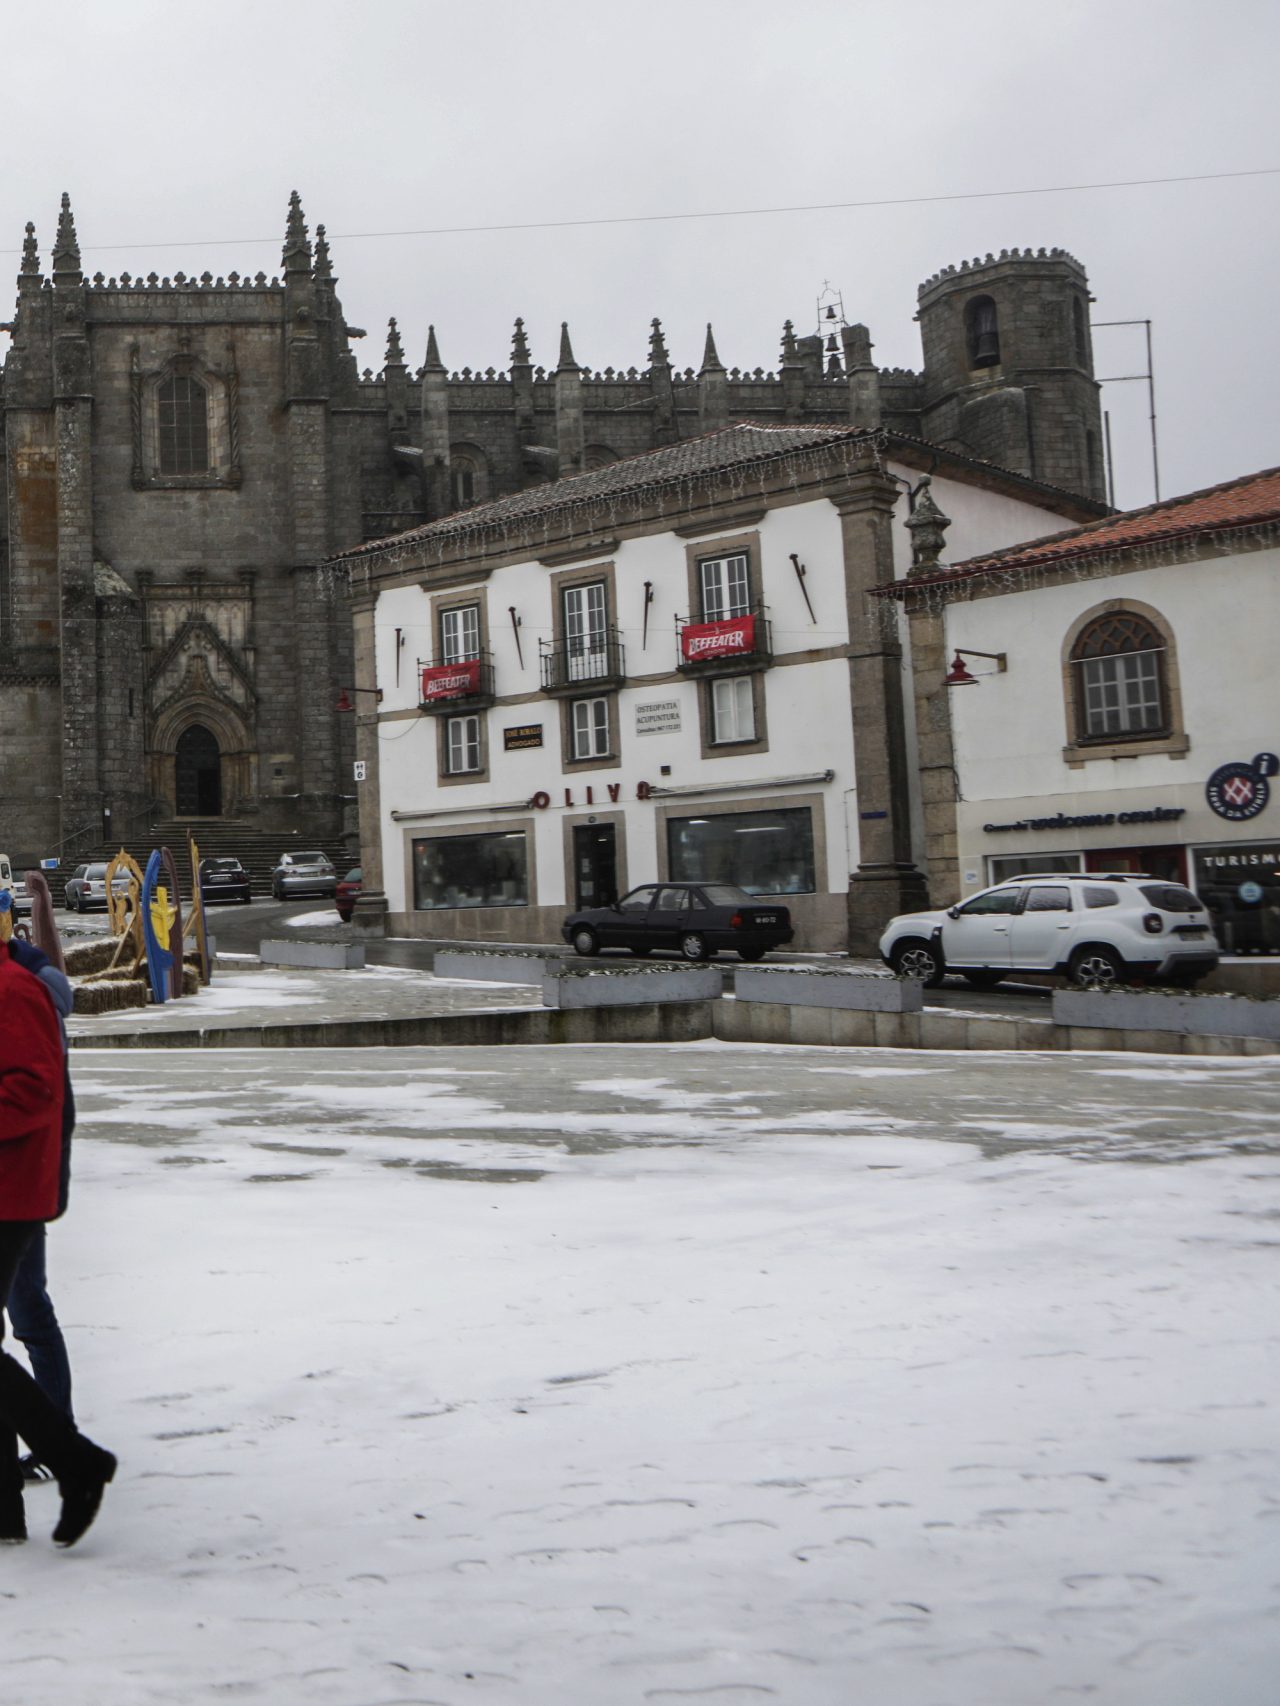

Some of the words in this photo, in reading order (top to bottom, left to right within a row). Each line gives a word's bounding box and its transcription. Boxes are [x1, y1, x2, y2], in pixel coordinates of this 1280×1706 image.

[688, 631, 744, 656] BEEFEATER
[426, 674, 470, 695] BEEFEATER
[637, 702, 678, 713] OSTEOPATIA
[636, 712, 680, 724] ACUPUNTURA
[534, 780, 650, 809] OLIVA
[1117, 806, 1185, 825] center
[1203, 854, 1280, 868] TURISM
